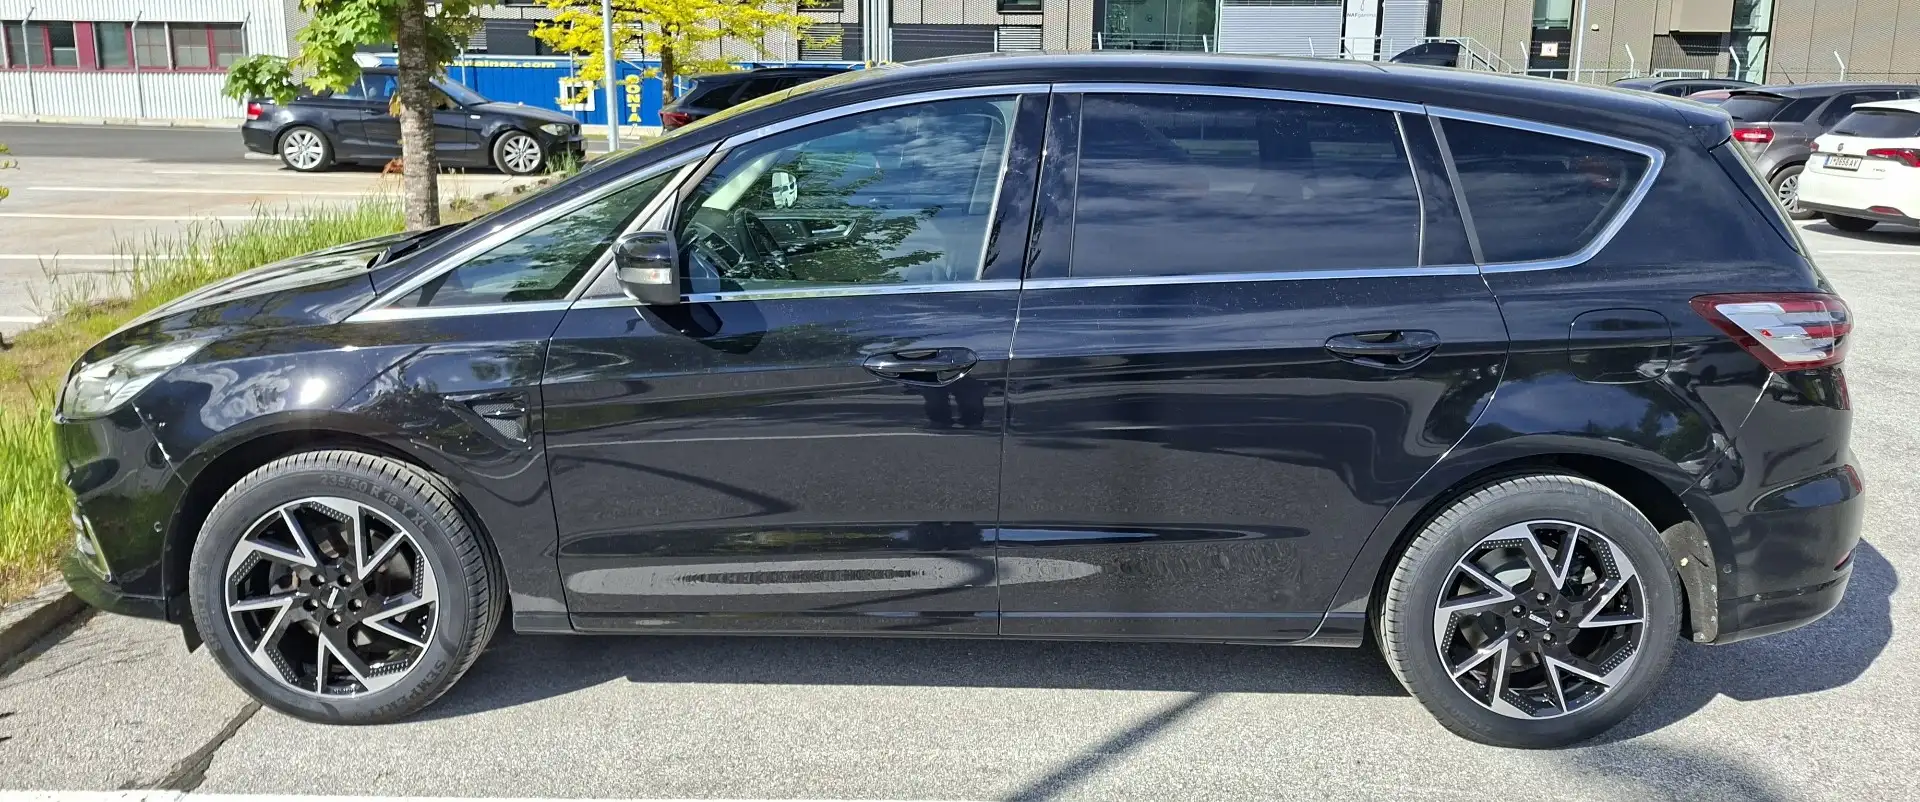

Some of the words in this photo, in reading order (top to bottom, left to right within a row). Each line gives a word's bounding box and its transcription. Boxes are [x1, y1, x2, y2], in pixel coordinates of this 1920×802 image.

[320, 474, 368, 492] 235/50
[369, 486, 381, 498] R
[384, 492, 399, 506] 18
[401, 502, 412, 514] Y
[412, 512, 428, 532] XL
